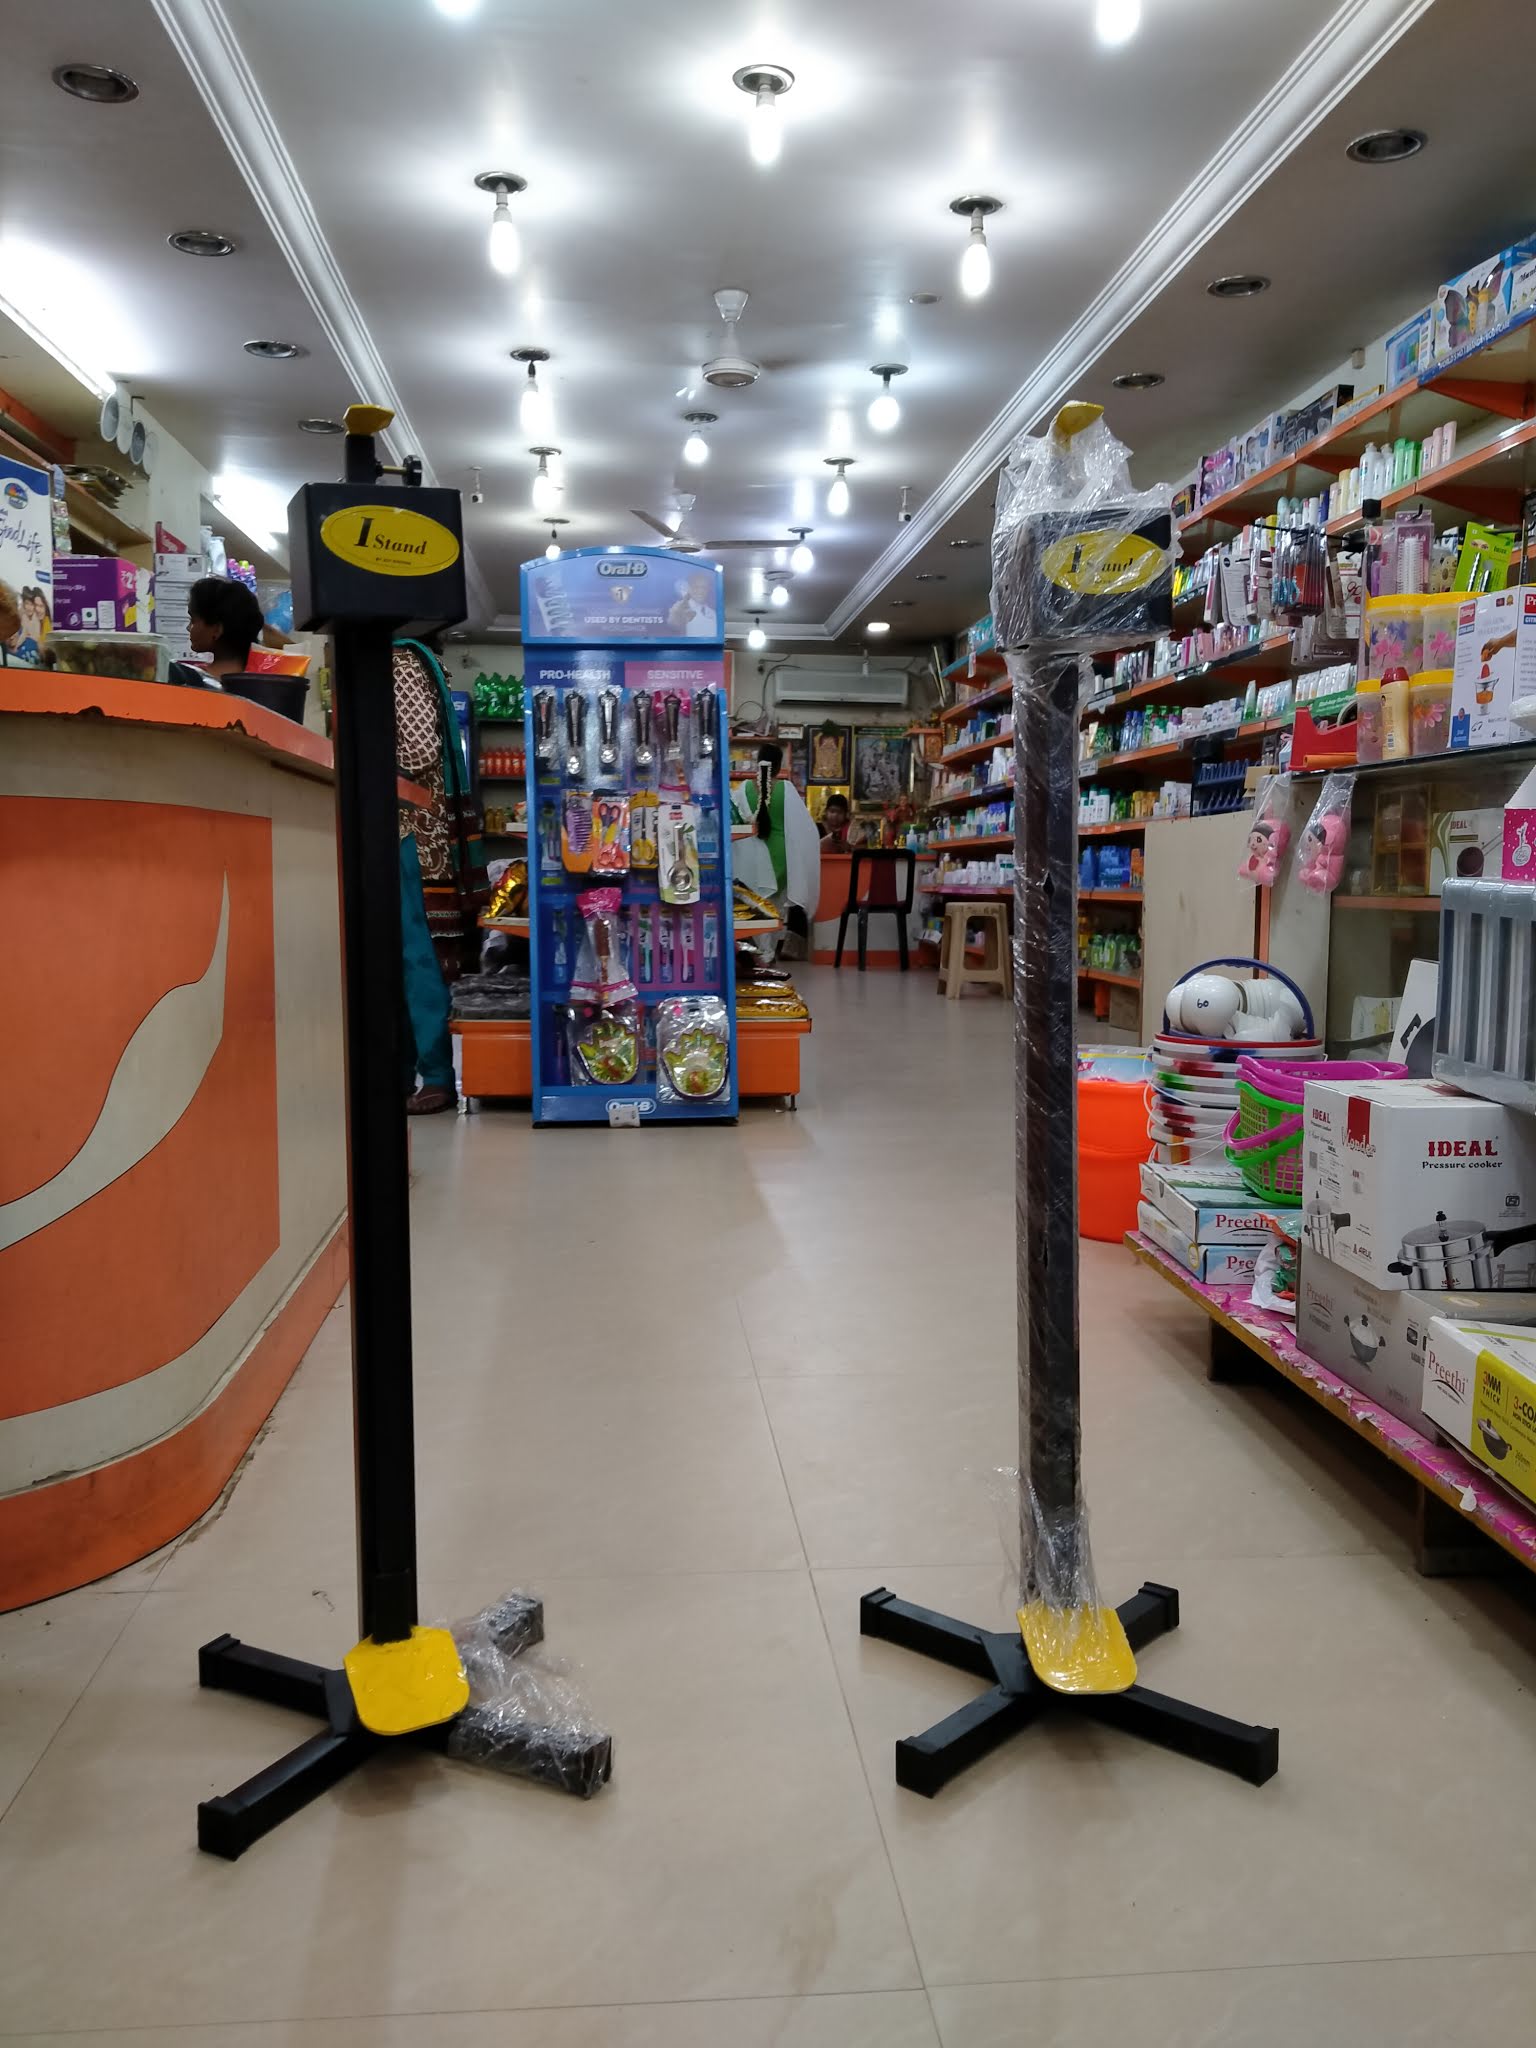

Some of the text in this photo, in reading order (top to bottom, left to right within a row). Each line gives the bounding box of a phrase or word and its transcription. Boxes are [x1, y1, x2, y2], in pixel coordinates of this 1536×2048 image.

[354, 516, 427, 555] I Stand
[600, 562, 647, 576] Oral-B
[584, 616, 664, 624] USED BY DENTISTS
[539, 669, 612, 681] PRO-HEALTH
[647, 669, 704, 680] SENSITIVE
[1312, 1107, 1331, 1124] IDEAL
[1427, 1140, 1498, 1157] IDEAL
[1422, 1160, 1503, 1169] Pressure cooker
[1215, 1214, 1272, 1229] Preeth
[1428, 1350, 1467, 1395] Preethi
[1483, 1386, 1501, 1406] THICK
